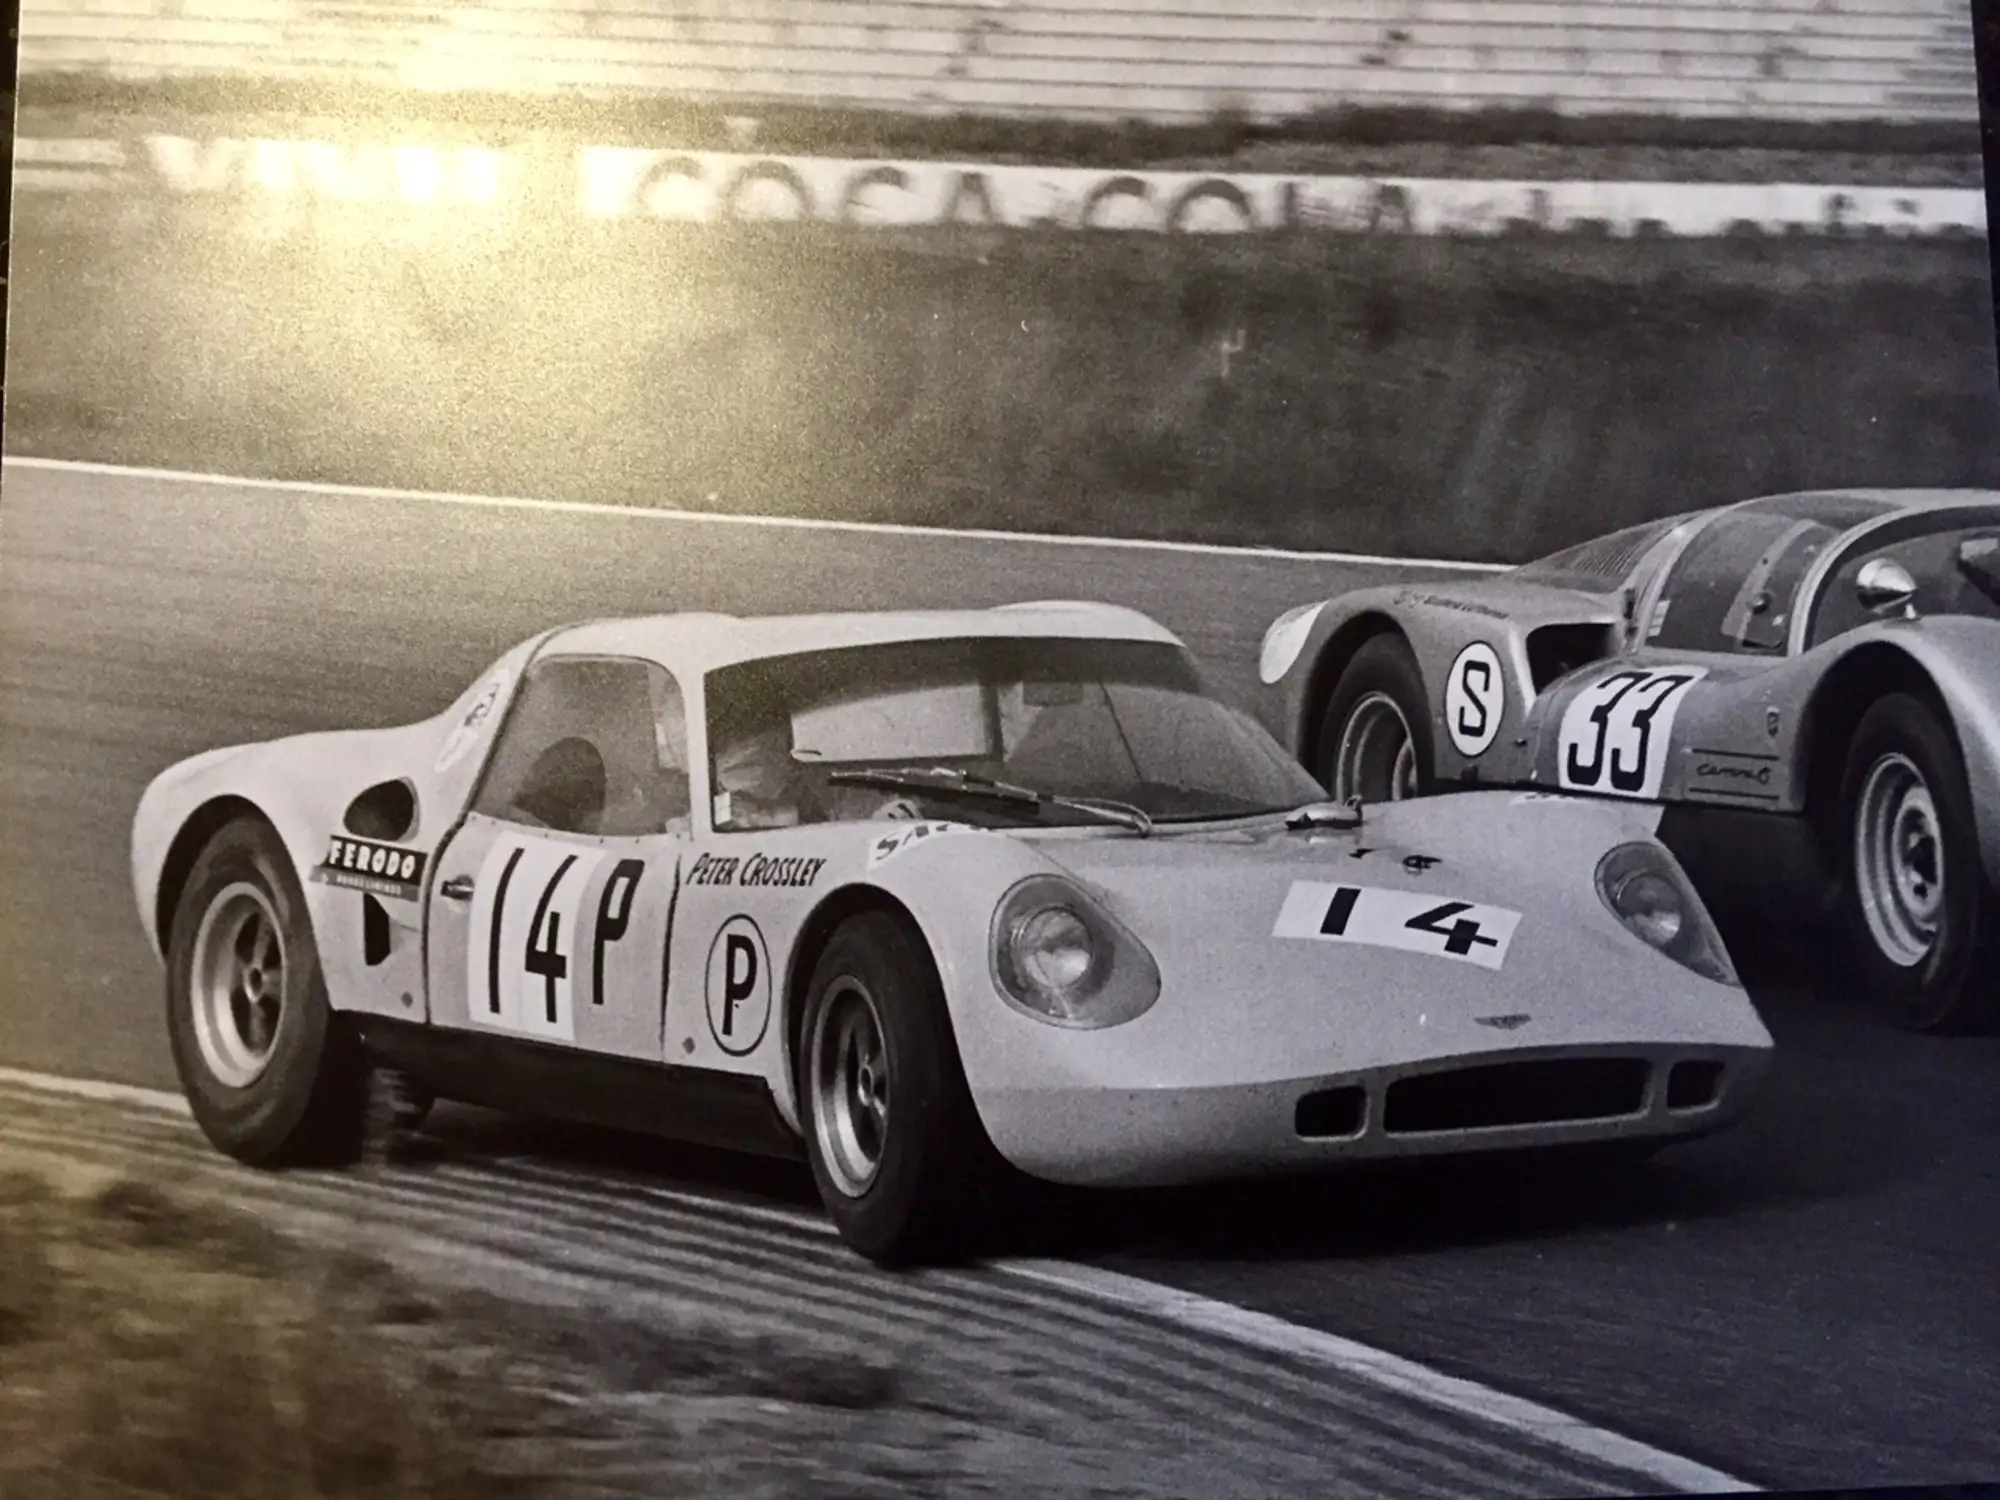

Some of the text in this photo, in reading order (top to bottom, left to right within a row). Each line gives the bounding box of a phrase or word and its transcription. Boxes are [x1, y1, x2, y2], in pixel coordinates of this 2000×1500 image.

[1458, 659, 1490, 738] S
[1567, 671, 1695, 793] 33
[328, 839, 416, 880] FERODO
[685, 851, 828, 887] PETER CROSSLEY
[721, 933, 758, 1037] P
